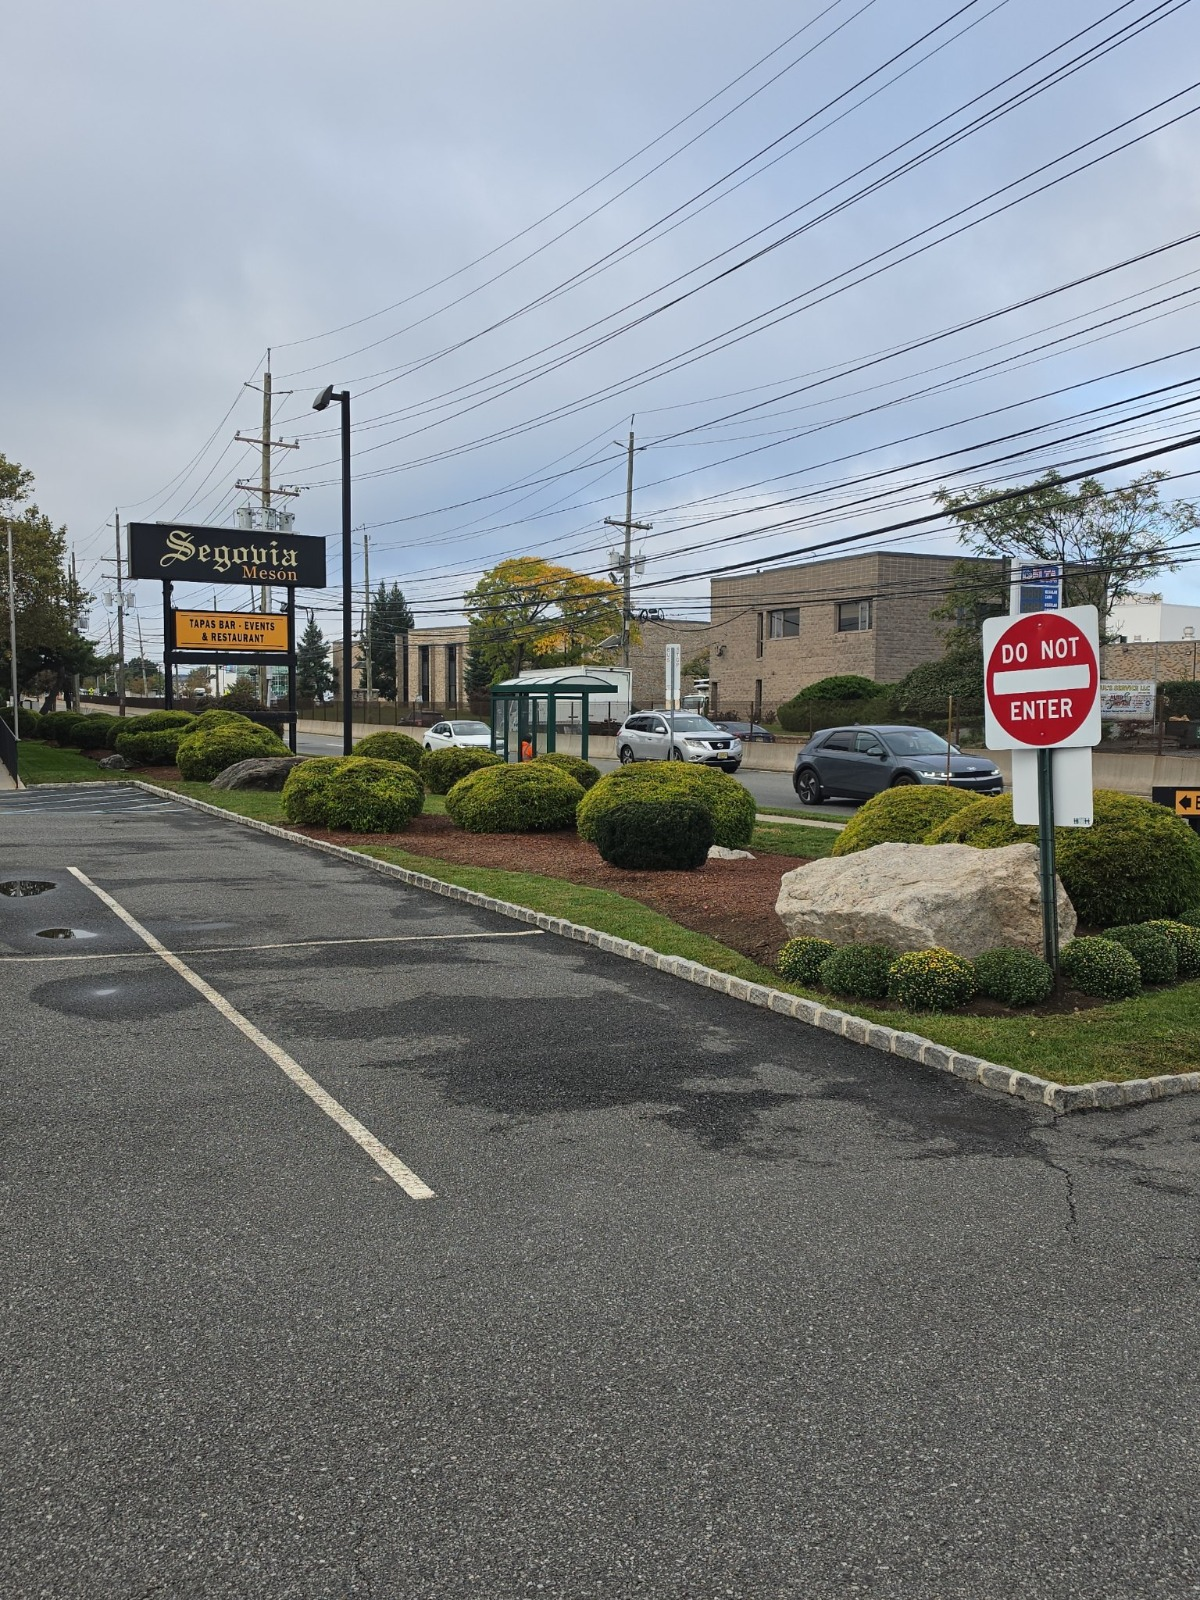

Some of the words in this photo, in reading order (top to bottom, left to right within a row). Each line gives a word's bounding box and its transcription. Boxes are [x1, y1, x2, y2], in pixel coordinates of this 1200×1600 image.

[159, 529, 299, 573] Segovia
[242, 565, 298, 581] Mesón
[189, 618, 216, 629] TAPAS
[219, 620, 236, 630] BAR
[244, 621, 275, 631] EVENTS
[201, 632, 208, 641] &
[211, 632, 264, 643] RESTAURANT
[1001, 642, 1028, 664] DO
[1041, 636, 1080, 660] NOT
[1010, 697, 1073, 721] ENTER
